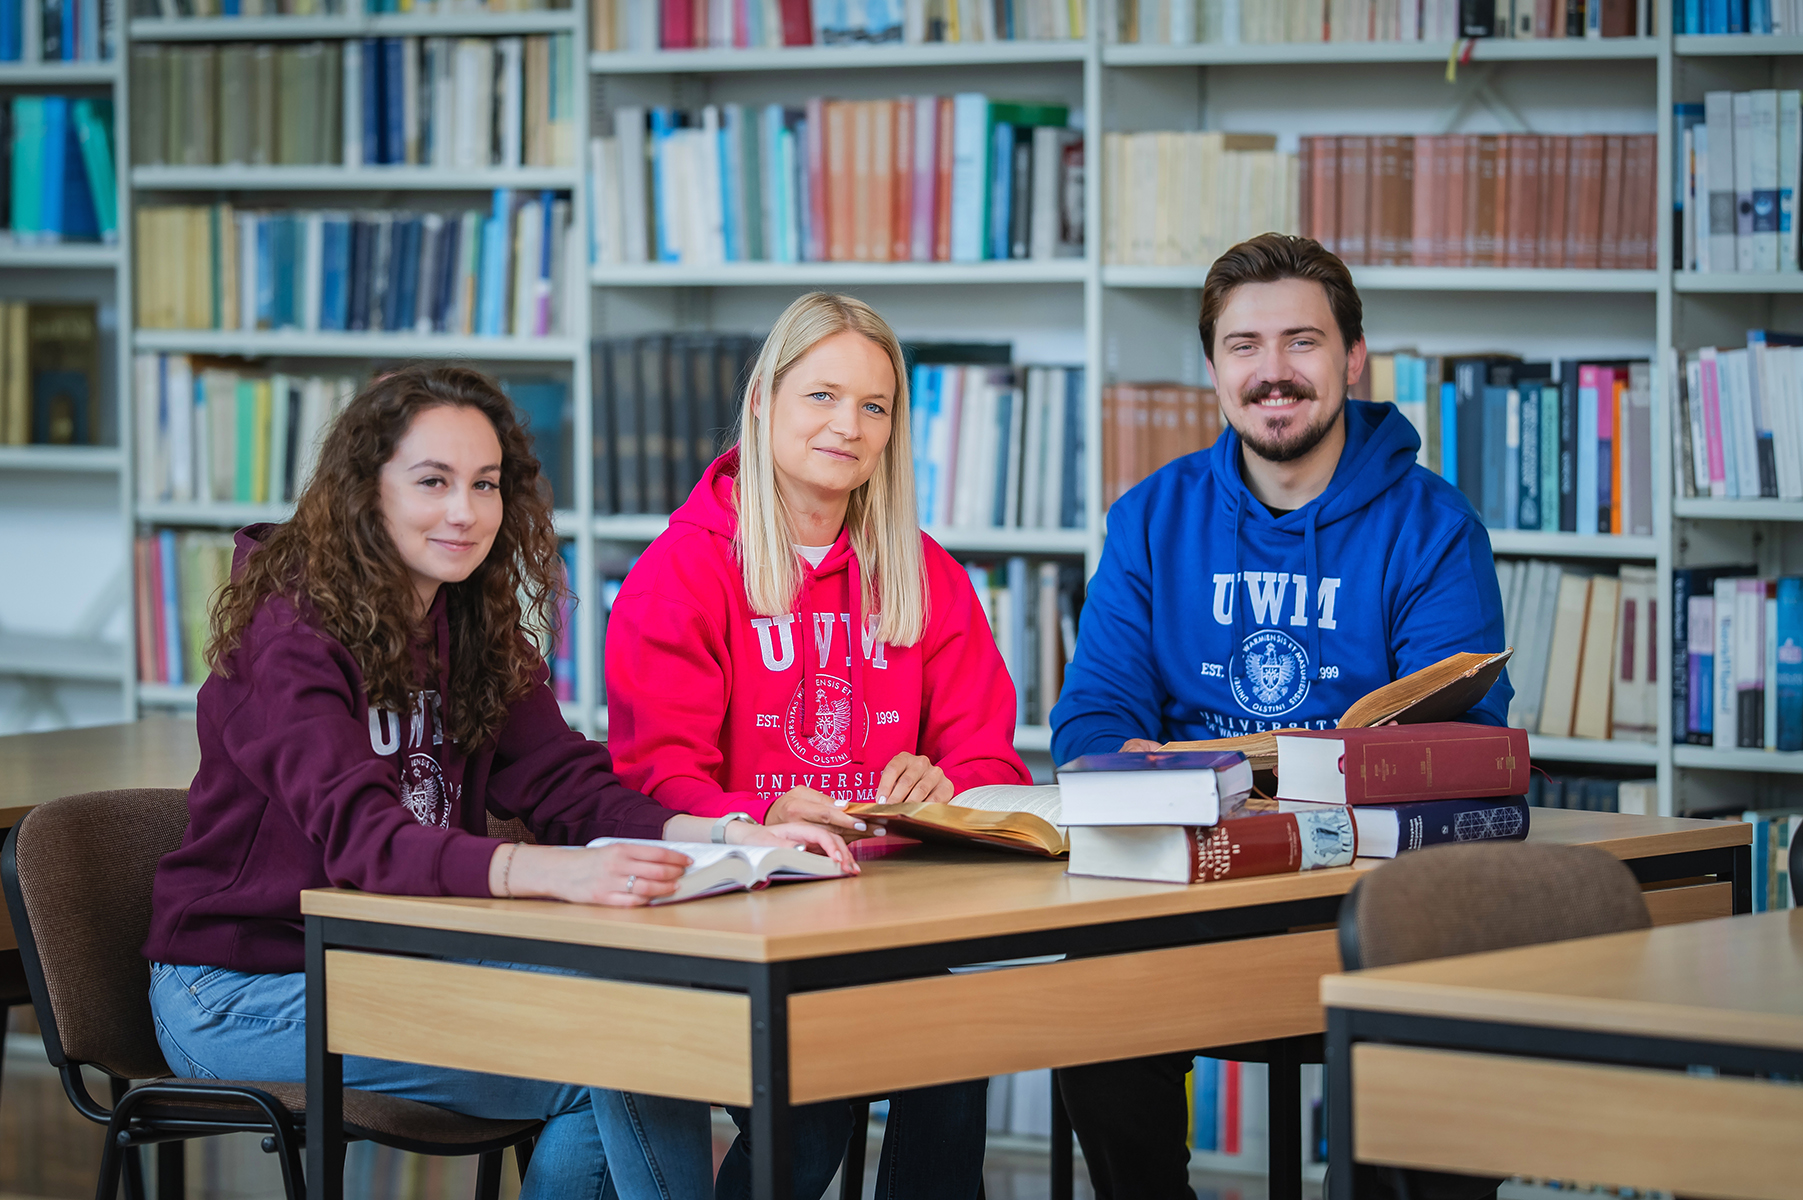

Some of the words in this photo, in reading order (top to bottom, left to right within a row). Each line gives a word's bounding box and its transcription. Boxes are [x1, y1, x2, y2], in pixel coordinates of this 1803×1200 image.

[1213, 570, 1341, 630] UWM
[751, 612, 888, 671] UWM
[1201, 662, 1225, 678] EST.
[1318, 665, 1339, 680] 999
[1252, 702, 1286, 713] OLSTINI
[756, 714, 781, 728] EST.
[875, 710, 900, 725] 1999
[788, 701, 807, 756] UNIVERSITAS
[813, 752, 849, 764] OLSTINI
[755, 771, 884, 789] UNIVERSI
[830, 789, 853, 801] AND
